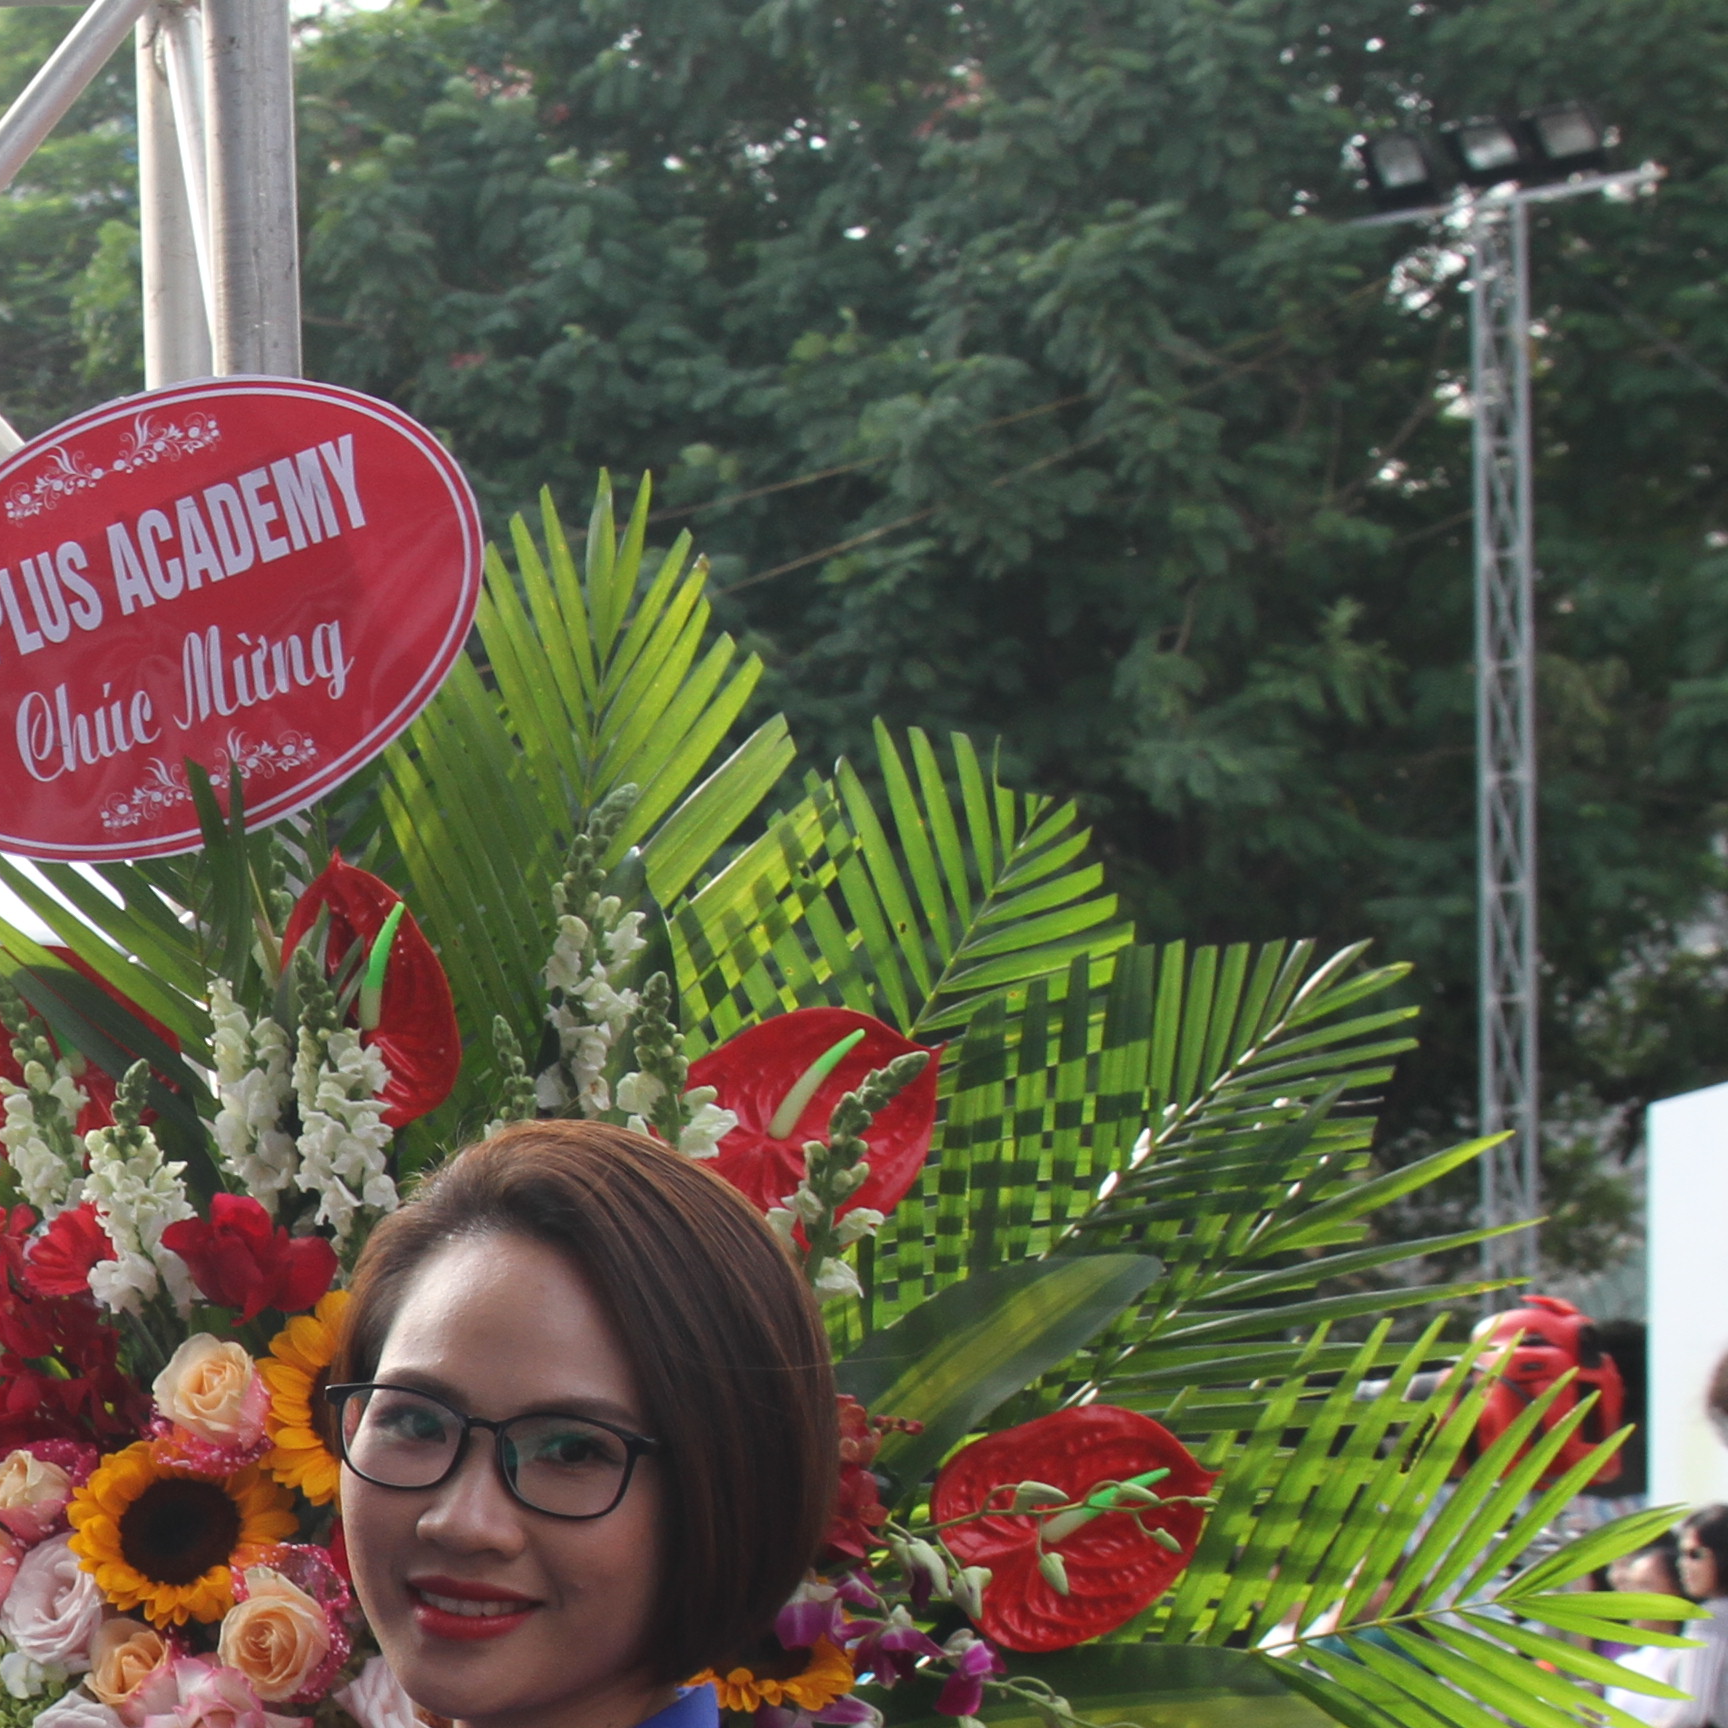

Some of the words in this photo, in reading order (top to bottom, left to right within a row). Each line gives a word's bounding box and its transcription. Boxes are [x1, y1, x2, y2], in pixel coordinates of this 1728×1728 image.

[105, 432, 367, 616] ACADEMY
[15, 680, 162, 782] Chúc
[173, 617, 356, 733] Mừng
